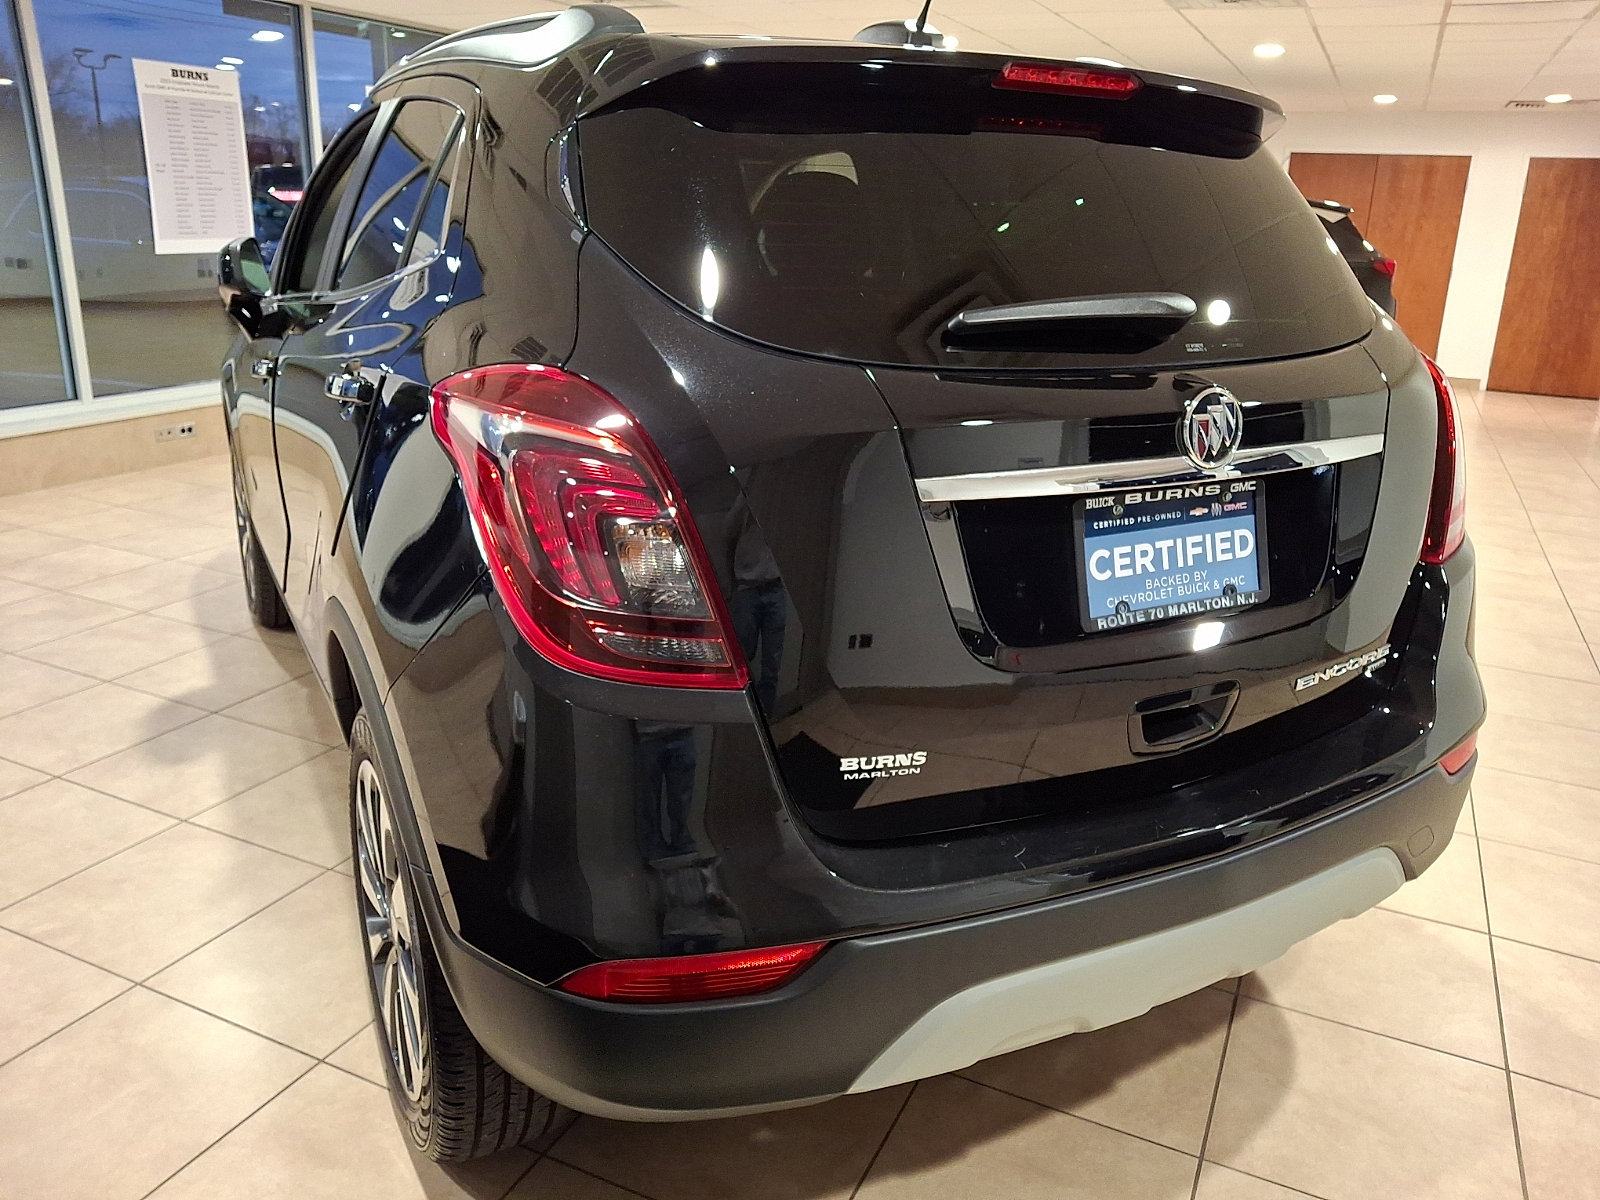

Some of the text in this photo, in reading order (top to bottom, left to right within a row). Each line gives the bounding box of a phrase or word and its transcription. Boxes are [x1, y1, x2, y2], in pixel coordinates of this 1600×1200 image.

[171, 68, 209, 81] BURNS
[1124, 484, 1221, 505] BURNS
[1230, 480, 1257, 493] GMC
[1085, 496, 1115, 510] BUICK
[1223, 501, 1248, 512] GMC
[1093, 518, 1135, 530] CERTIFIED
[1089, 528, 1255, 581] CERTIFIED
[1145, 570, 1208, 590] BACKED BY
[1177, 582, 1210, 597] BUICK
[1213, 579, 1220, 590] &
[1097, 610, 1146, 629] ROUTE
[1150, 607, 1165, 621] 70
[1295, 643, 1391, 691] ENCORE
[840, 751, 928, 772] BURNS
[843, 767, 921, 781] MARLTON
